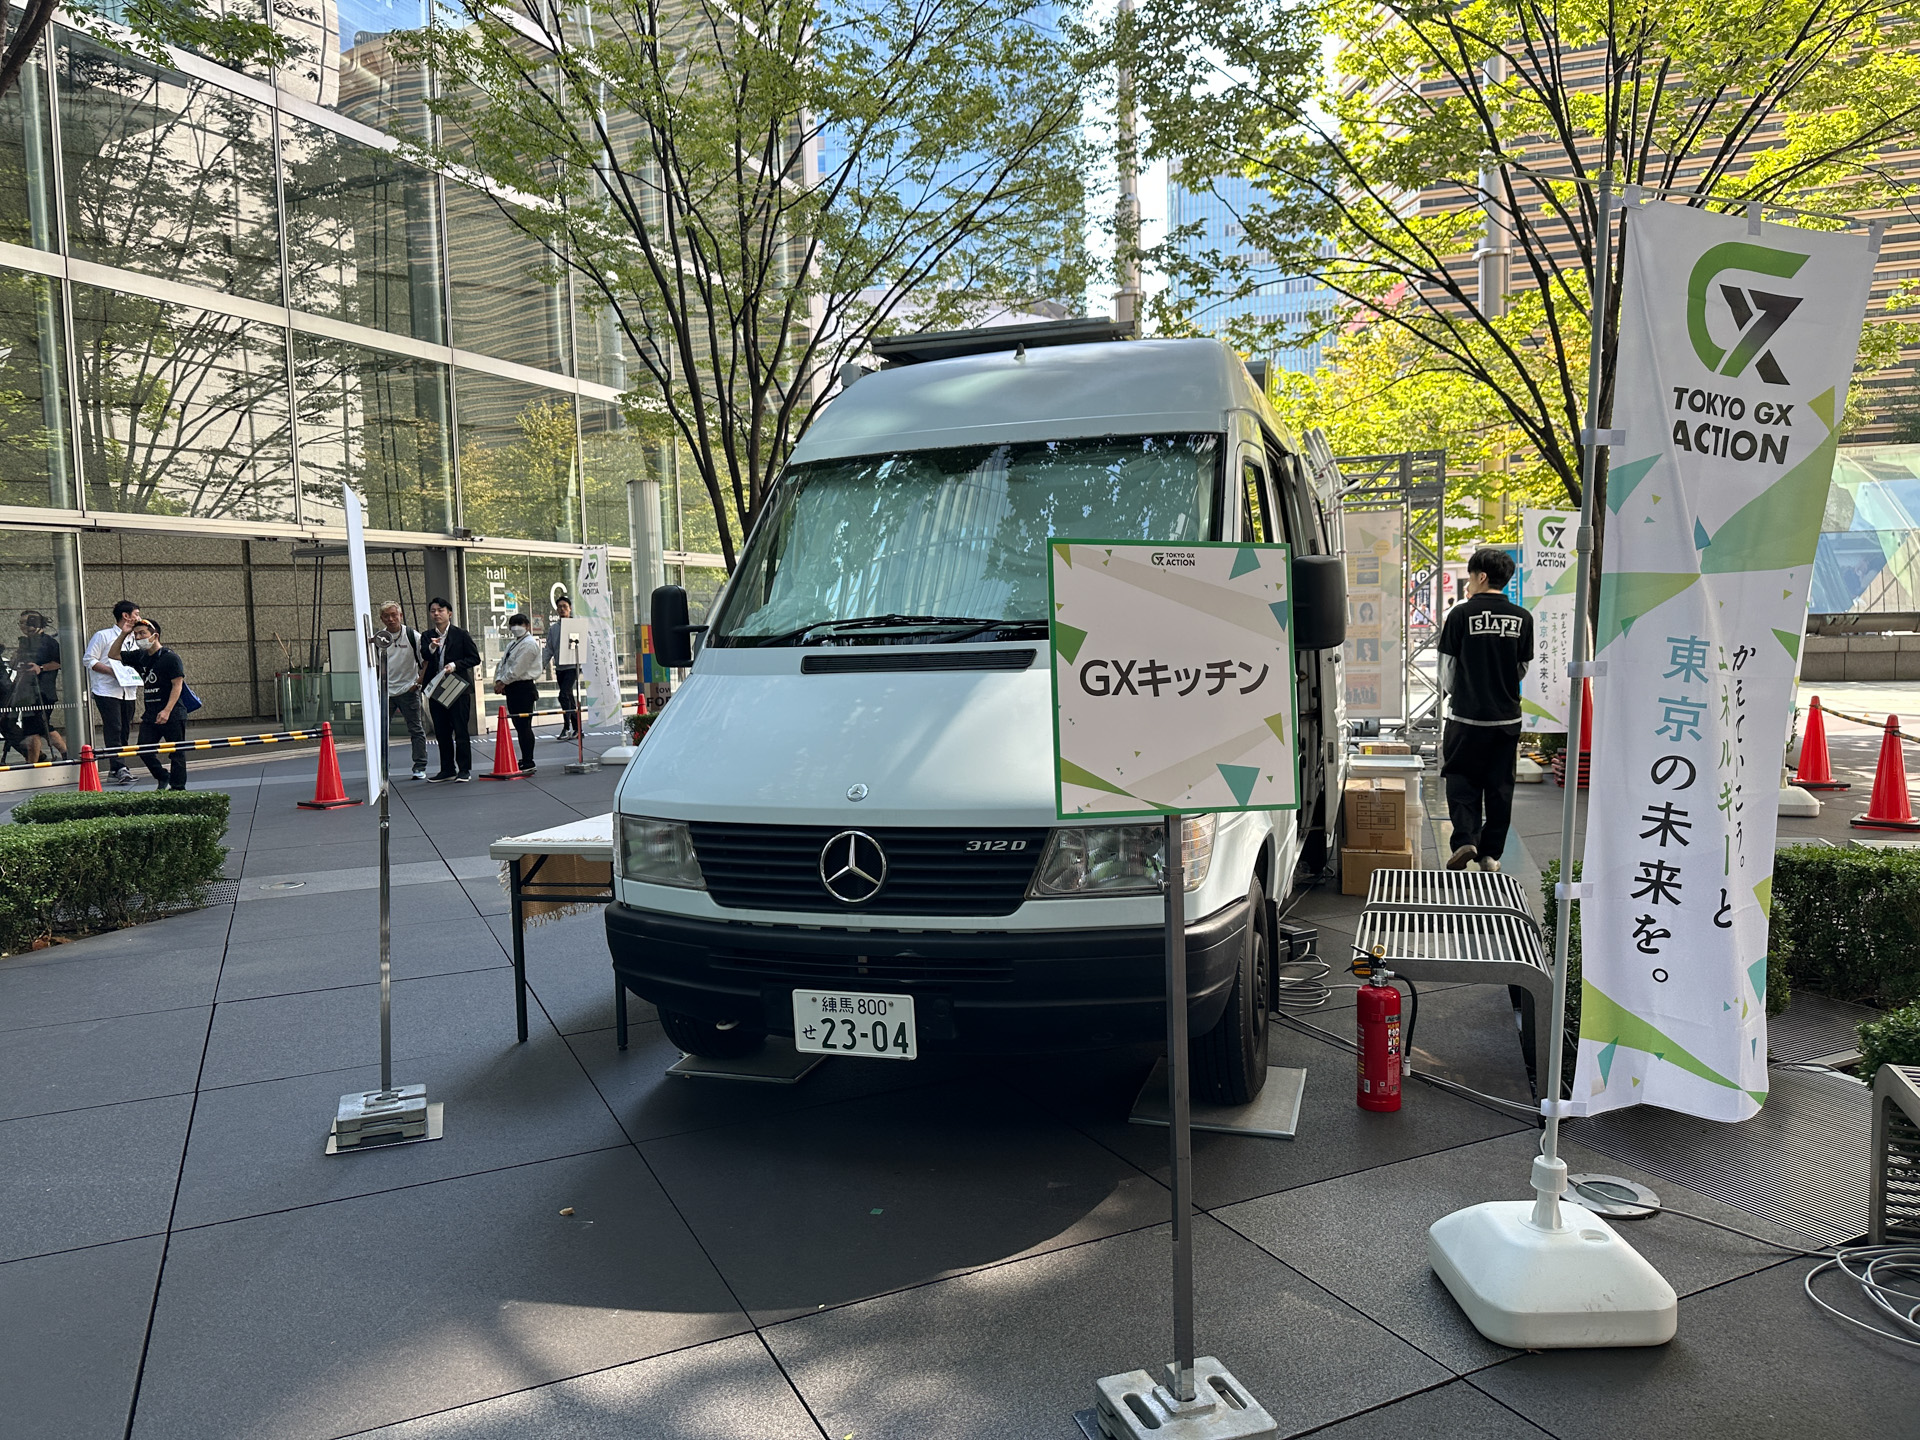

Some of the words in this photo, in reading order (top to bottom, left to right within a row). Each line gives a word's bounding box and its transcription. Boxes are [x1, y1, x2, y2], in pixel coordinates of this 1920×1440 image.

[1672, 386, 1746, 421] TOKYO
[1753, 401, 1795, 427] GX
[1672, 420, 1790, 465] ACTION
[486, 566, 507, 580] hall
[1536, 559, 1566, 568] ACTION
[489, 582, 506, 612] E
[1474, 610, 1518, 638] STAFF
[1539, 611, 1549, 700] 東京の未来を。
[1550, 612, 1558, 684] エネルギーと
[1078, 658, 1270, 698] GXキッチン
[1630, 634, 1711, 984] 東京の未来を。
[821, 996, 854, 1014] 練馬
[857, 998, 887, 1016] 800
[820, 1017, 909, 1054] 23-04
